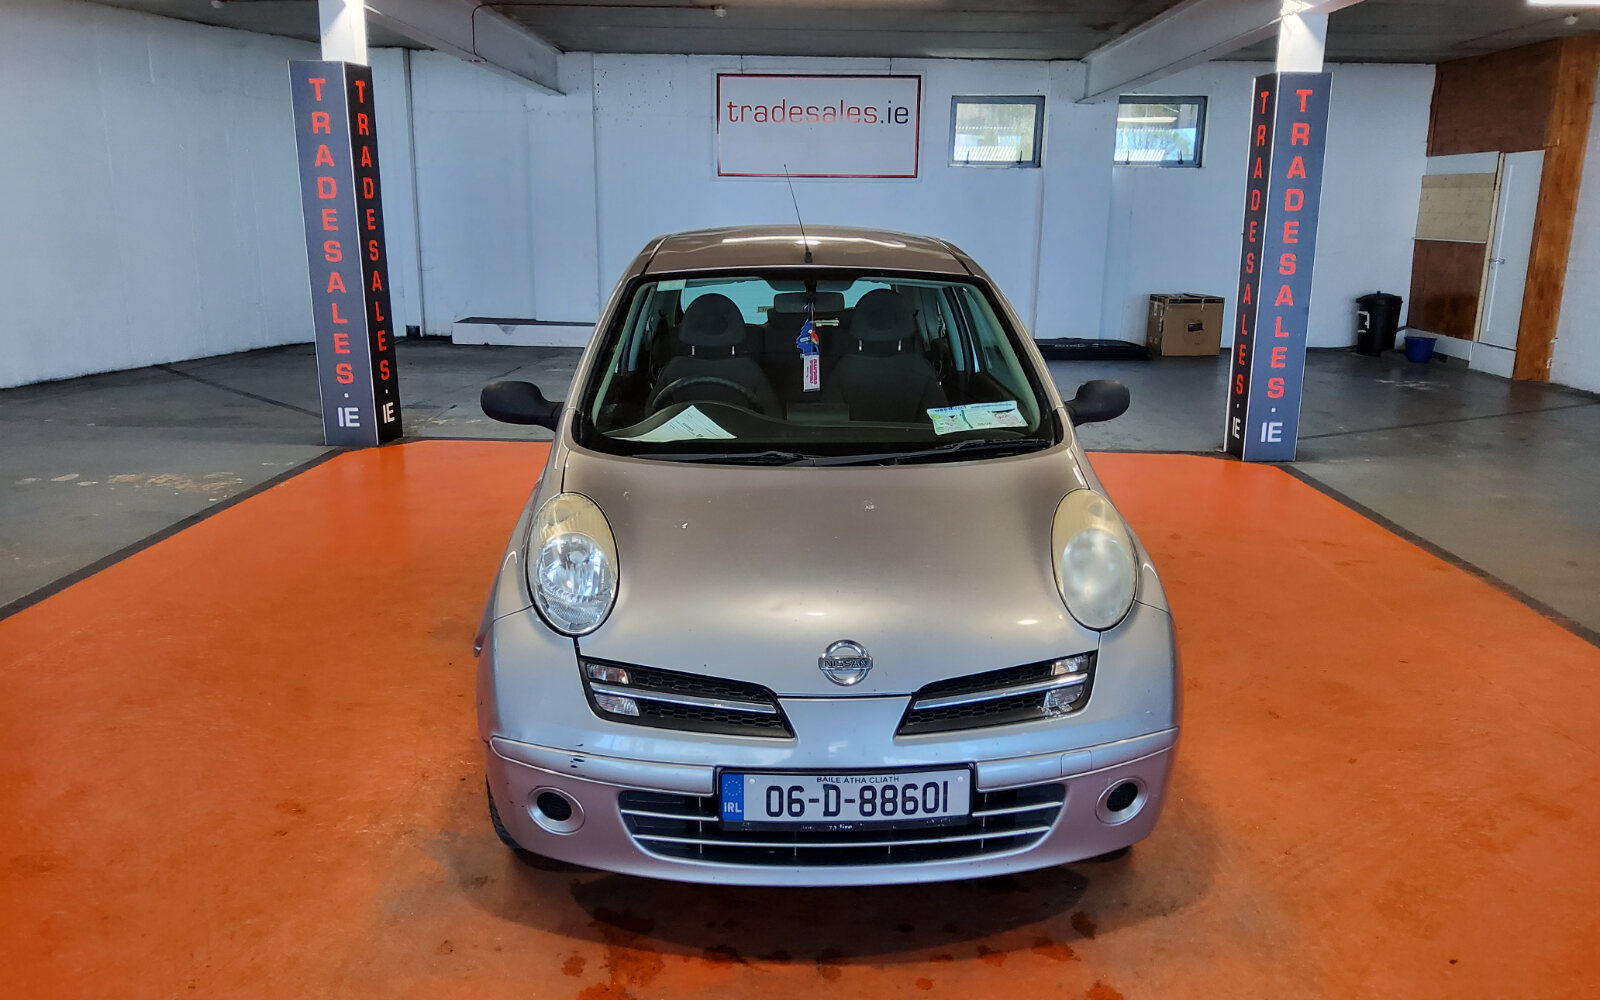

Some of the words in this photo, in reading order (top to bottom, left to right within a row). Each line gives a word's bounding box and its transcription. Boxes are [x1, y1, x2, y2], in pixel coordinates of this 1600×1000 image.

[727, 98, 910, 125] tradesales.ie
[824, 660, 868, 668] NISSAN
[816, 776, 841, 784] BAILE
[868, 775, 900, 784] CLIATH
[765, 780, 949, 818] 06-D-88601
[723, 801, 743, 813] IRL
